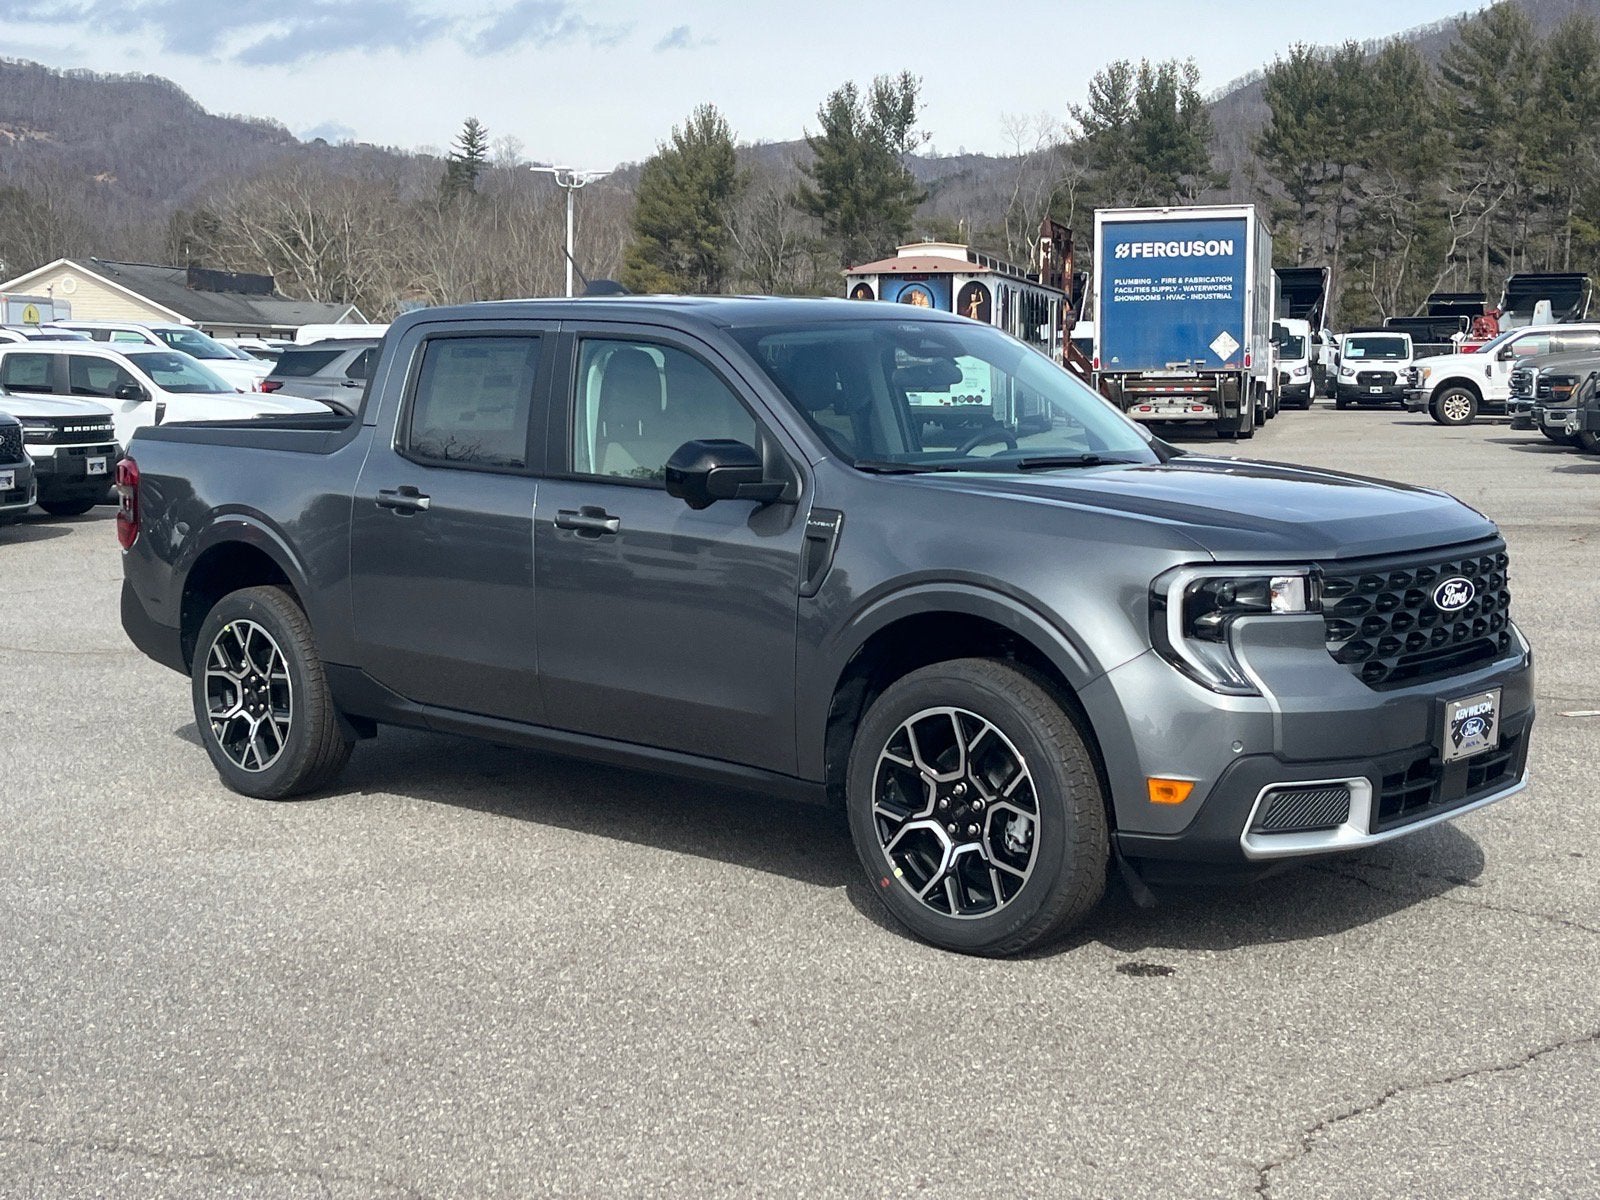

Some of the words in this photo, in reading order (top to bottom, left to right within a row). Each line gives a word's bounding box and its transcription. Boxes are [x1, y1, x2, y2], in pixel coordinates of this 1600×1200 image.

[1132, 240, 1234, 258] FERGUSON
[1114, 286, 1150, 294] FACILITIES
[1151, 285, 1177, 293] SUPPLY
[1183, 284, 1233, 292] WATERWORKS
[1114, 294, 1161, 302] SHOWROOMS
[1166, 293, 1186, 301] HVAC
[1442, 583, 1468, 607] Ford
[1454, 706, 1470, 721] KEN
[1469, 700, 1492, 717] WILSON
[1464, 719, 1481, 737] Ford
